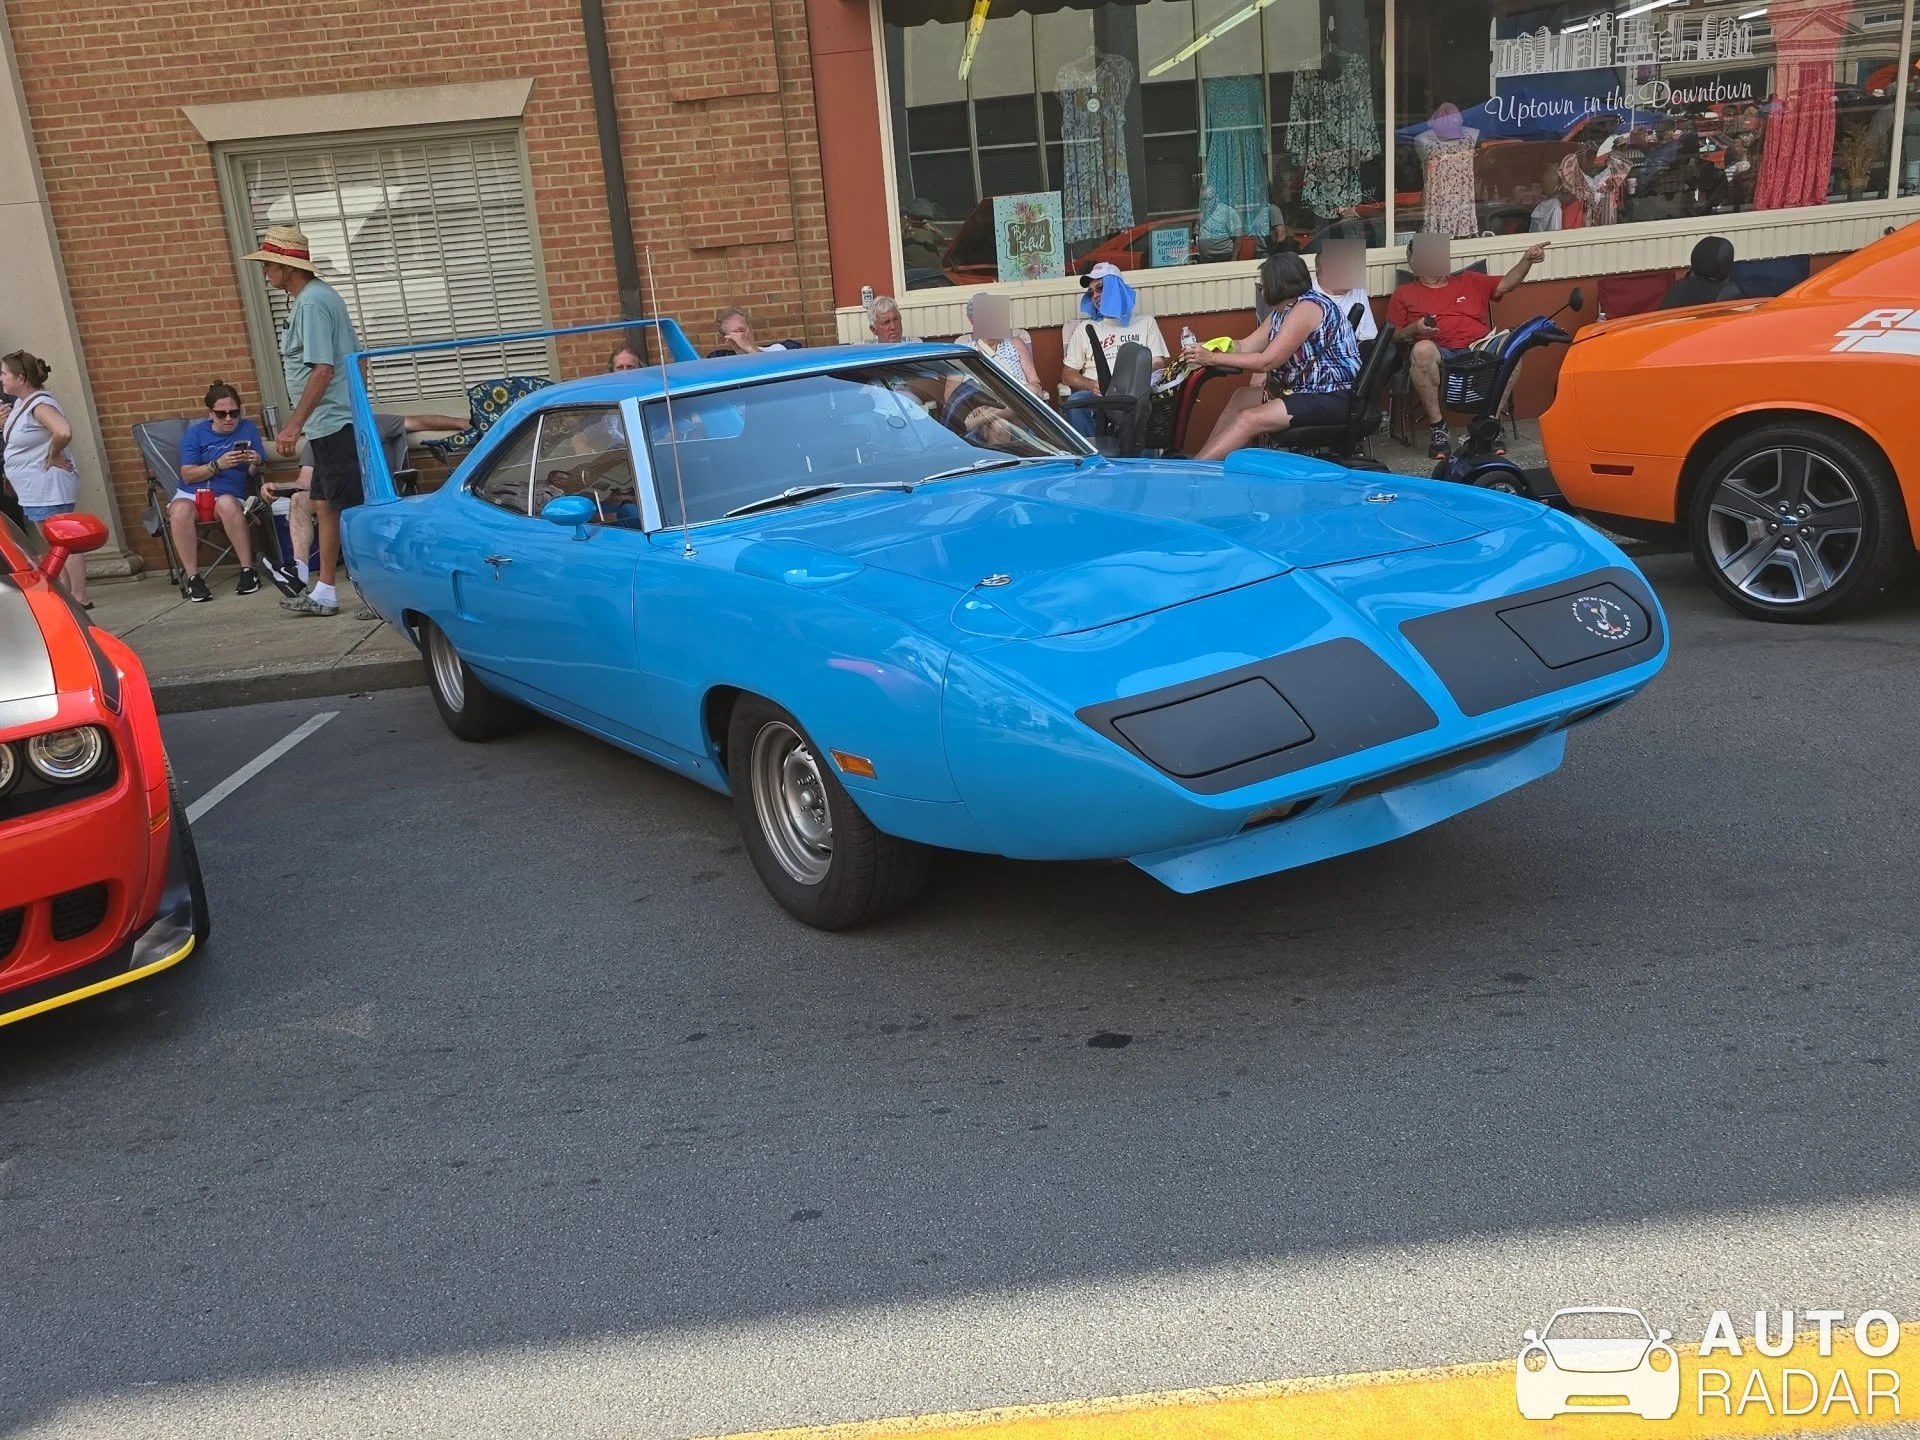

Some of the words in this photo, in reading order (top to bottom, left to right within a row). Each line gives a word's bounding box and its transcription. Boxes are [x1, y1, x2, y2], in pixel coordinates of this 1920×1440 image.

[1484, 96, 1575, 127] Uptown
[1584, 96, 1602, 113] in
[1606, 85, 1634, 110] the
[1638, 80, 1753, 108] Downtown
[1010, 224, 1027, 241] Be
[1019, 234, 1046, 252] tiful
[1120, 334, 1140, 343] CLEAN
